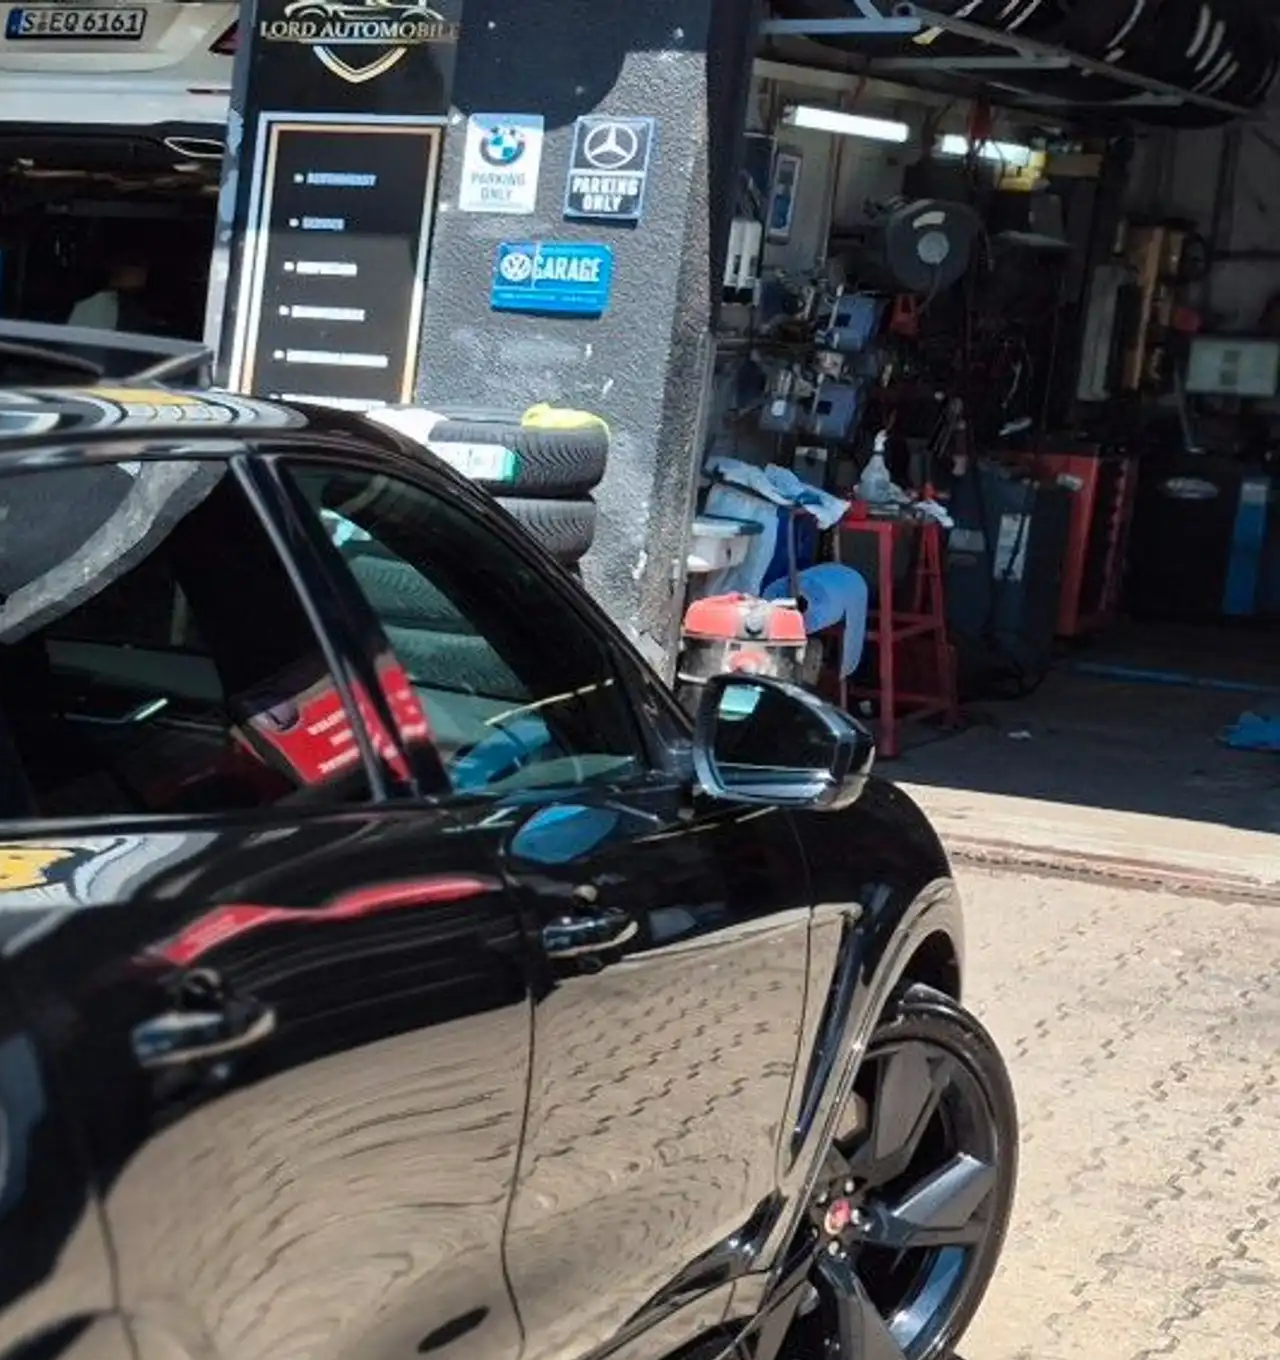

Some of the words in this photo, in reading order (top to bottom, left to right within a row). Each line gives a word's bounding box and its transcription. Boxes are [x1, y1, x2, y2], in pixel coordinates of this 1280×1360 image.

[22, 12, 38, 32] S
[83, 12, 138, 32] 6161
[259, 20, 316, 38] LORD
[572, 176, 639, 196] PARKING
[582, 194, 623, 212] ONLY
[533, 256, 603, 282] GARAGE
